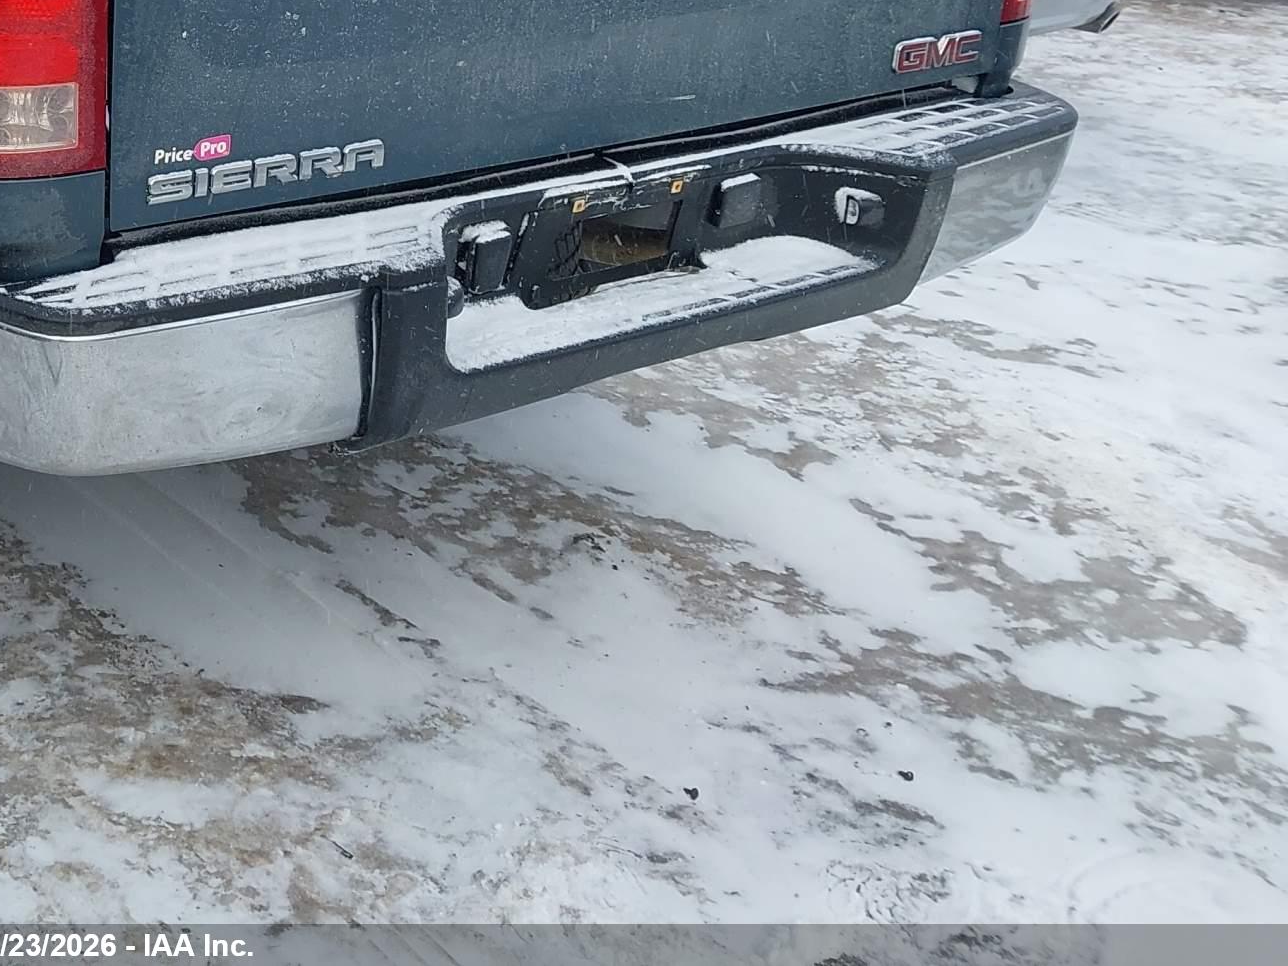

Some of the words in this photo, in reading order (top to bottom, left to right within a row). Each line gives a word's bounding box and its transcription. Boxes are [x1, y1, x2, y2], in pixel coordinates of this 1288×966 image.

[893, 30, 982, 74] GMC
[147, 138, 385, 205] SIERRA
[154, 147, 193, 164] Price
[200, 141, 227, 157] Pro
